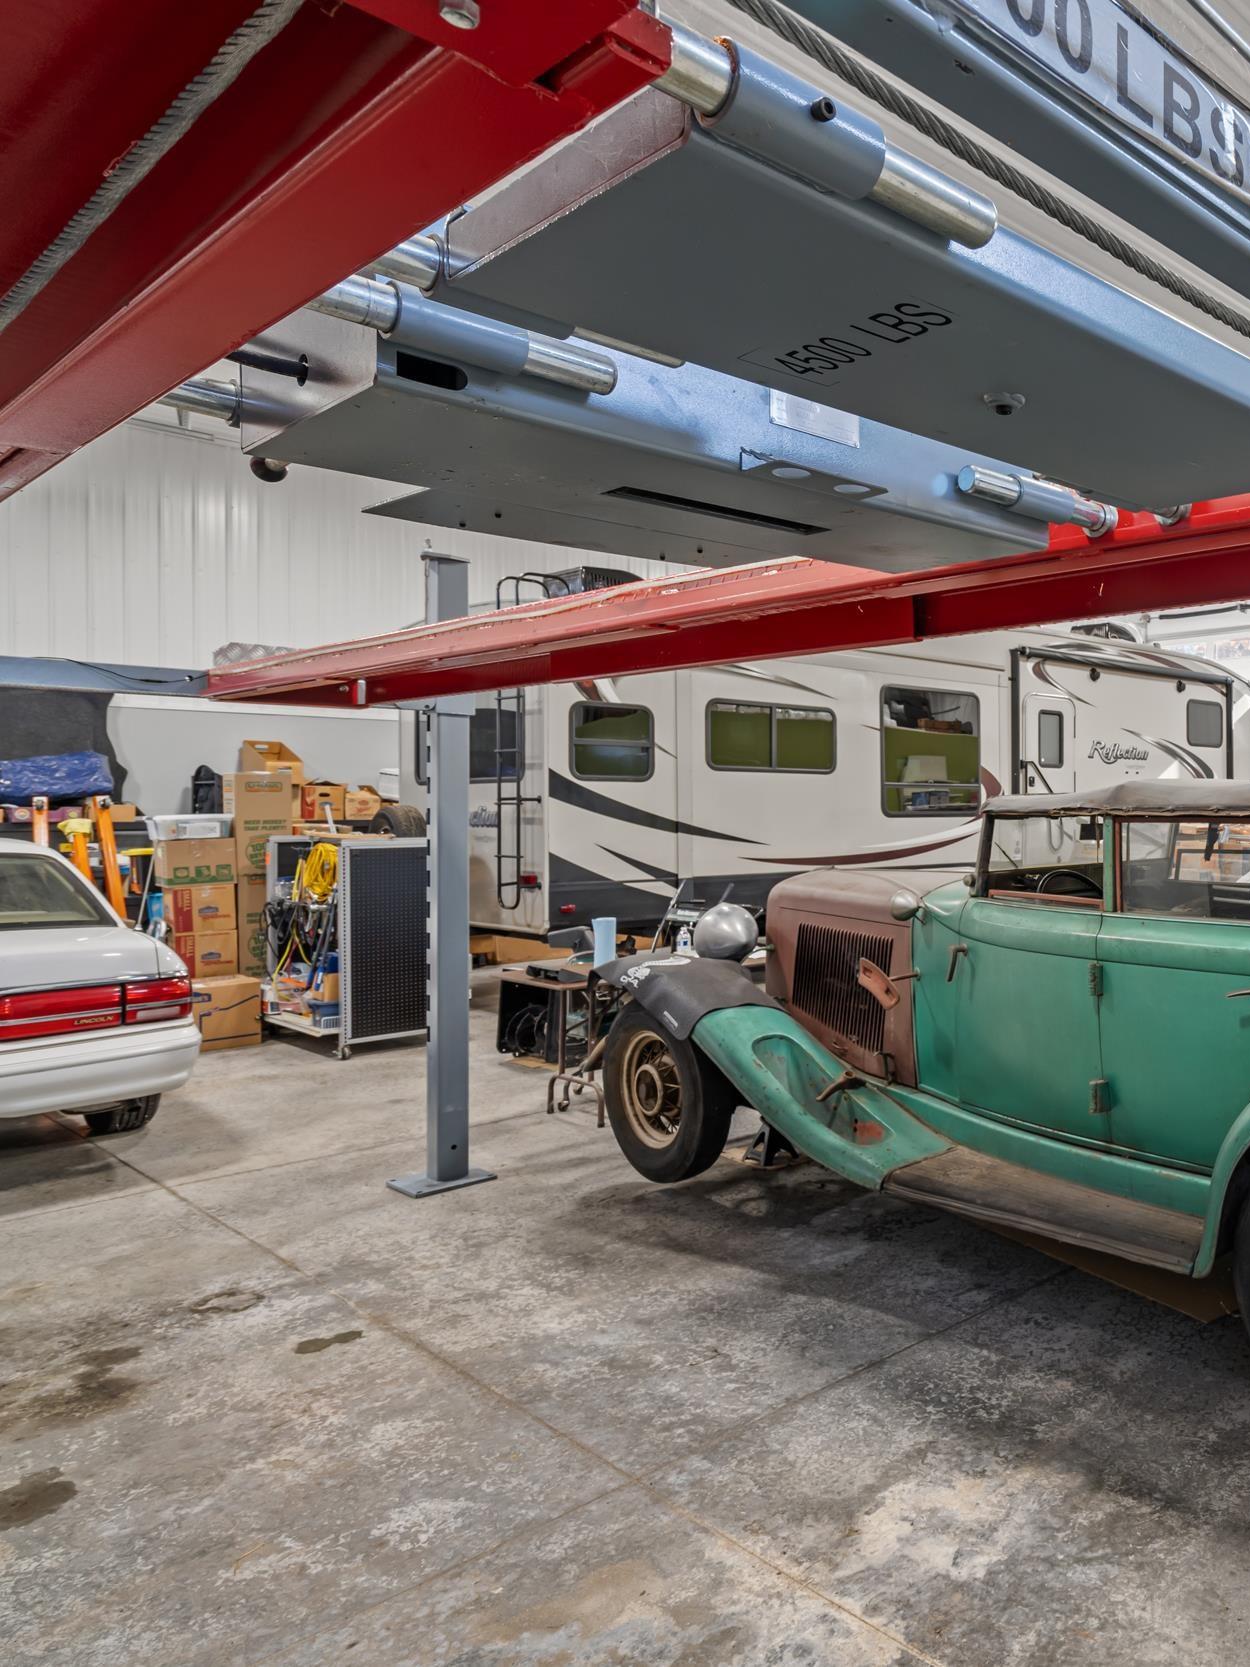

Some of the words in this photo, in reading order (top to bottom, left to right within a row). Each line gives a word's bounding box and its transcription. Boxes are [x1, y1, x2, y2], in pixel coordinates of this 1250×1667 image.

[1116, 22, 1245, 188] LBS
[774, 337, 872, 375] 4500
[850, 303, 953, 344] LBS
[1088, 740, 1149, 765] Reflection
[73, 1016, 114, 1025] LINCOLN
